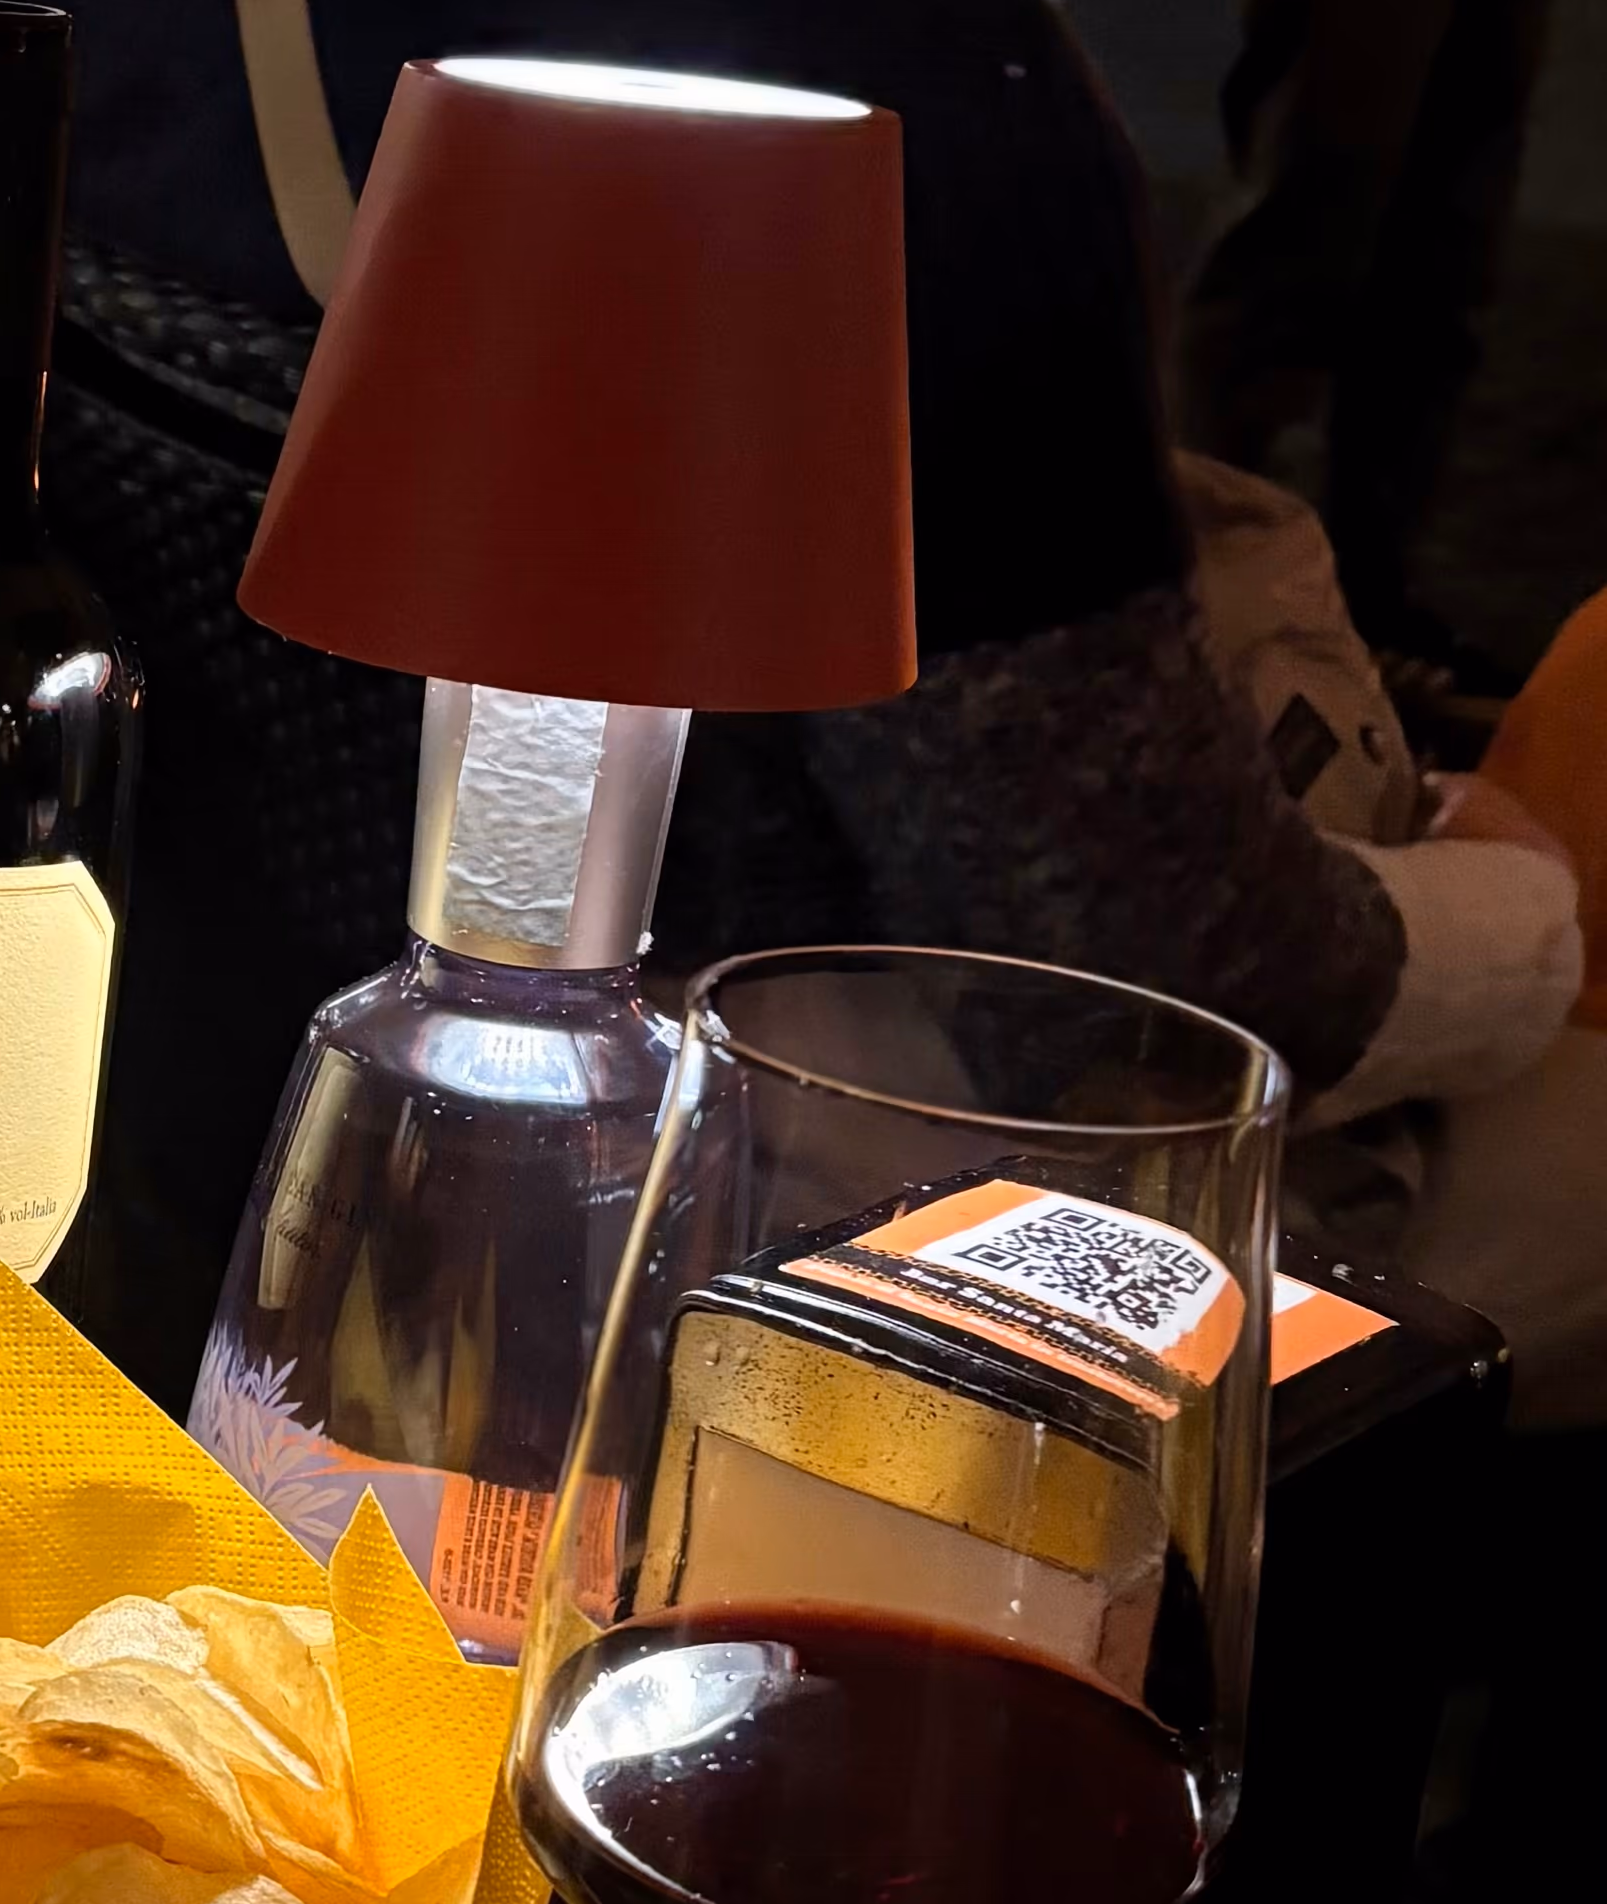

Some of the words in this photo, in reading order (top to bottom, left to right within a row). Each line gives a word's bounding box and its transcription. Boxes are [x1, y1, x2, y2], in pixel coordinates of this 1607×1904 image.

[900, 1268, 958, 1290] Bar
[958, 1286, 1043, 1324] Santa
[1044, 1320, 1129, 1363] Maria
